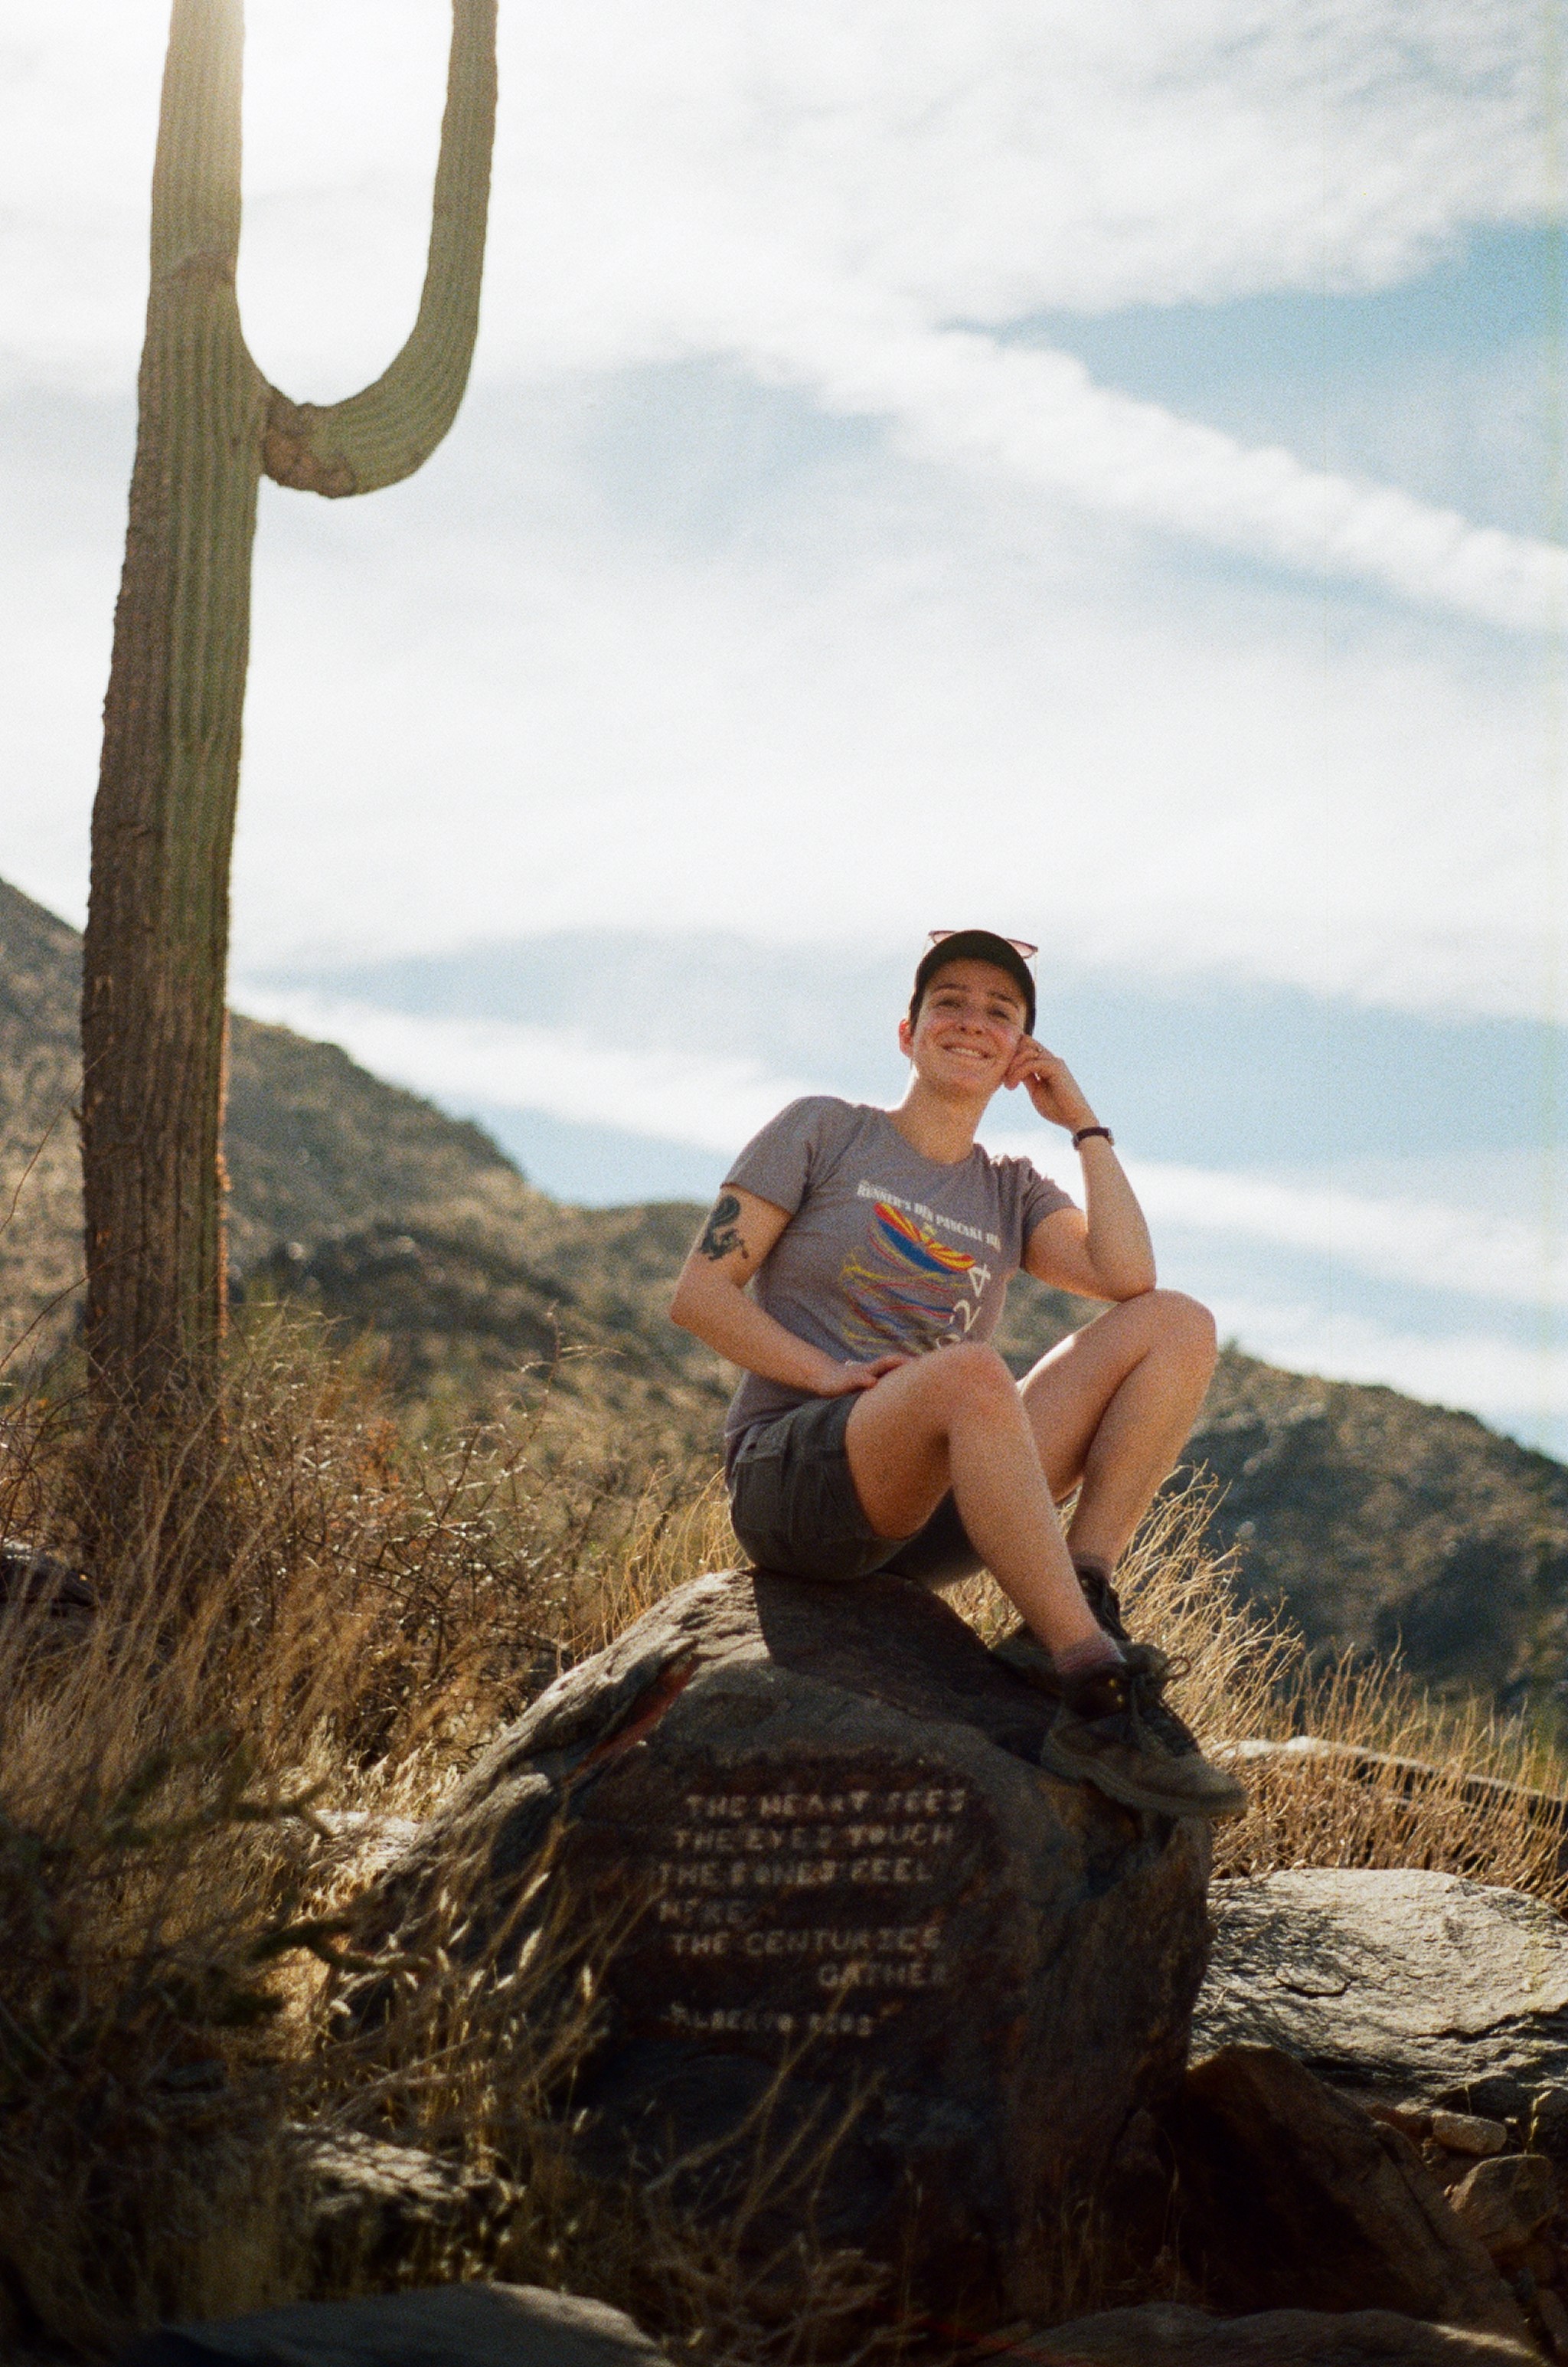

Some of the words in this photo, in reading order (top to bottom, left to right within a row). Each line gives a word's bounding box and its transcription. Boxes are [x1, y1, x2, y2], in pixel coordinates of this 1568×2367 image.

[684, 1795, 746, 1818] THE
[760, 1790, 870, 1818] HEART
[674, 1828, 734, 1851] THE
[743, 1826, 834, 1851] EYES
[848, 1823, 955, 1847] TOUCH
[658, 1862, 724, 1885] THE
[671, 1931, 732, 1956] THE
[745, 1926, 942, 1957] CENTURIES
